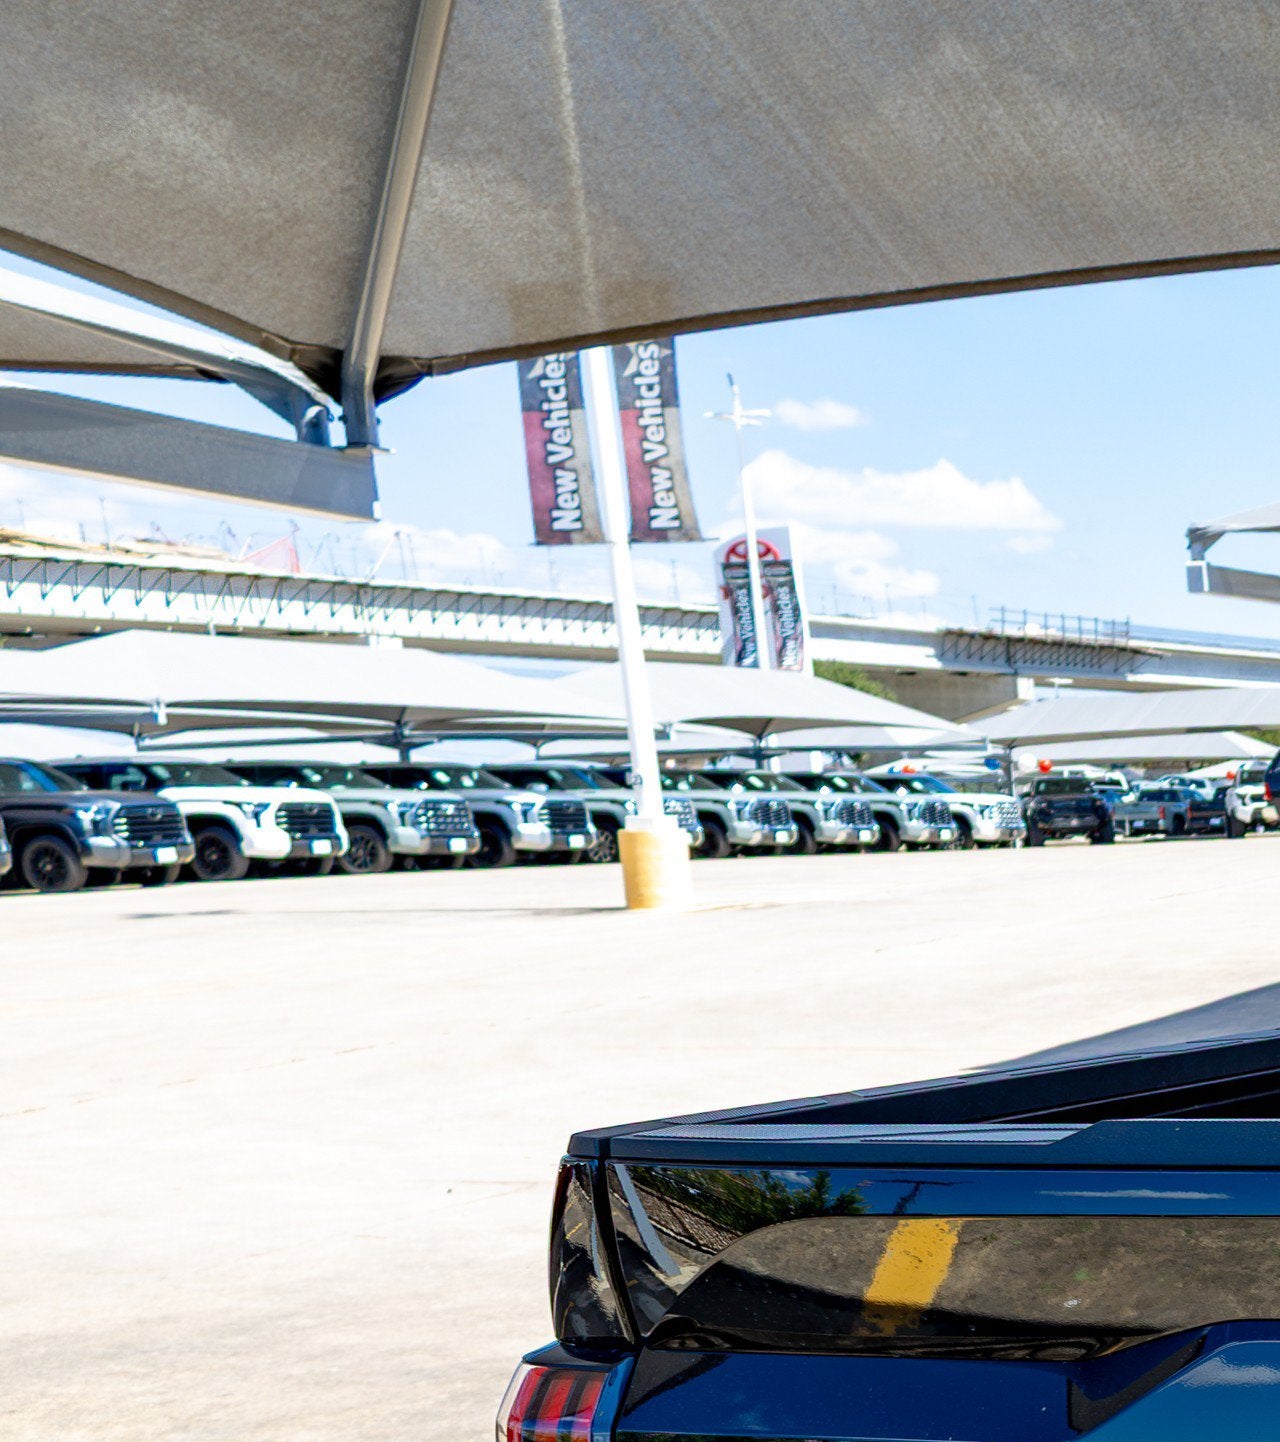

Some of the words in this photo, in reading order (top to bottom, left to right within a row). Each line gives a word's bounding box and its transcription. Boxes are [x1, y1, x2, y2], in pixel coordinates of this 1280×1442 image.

[634, 342, 668, 462] Vehicles
[551, 467, 583, 531] New
[650, 467, 681, 529] New
